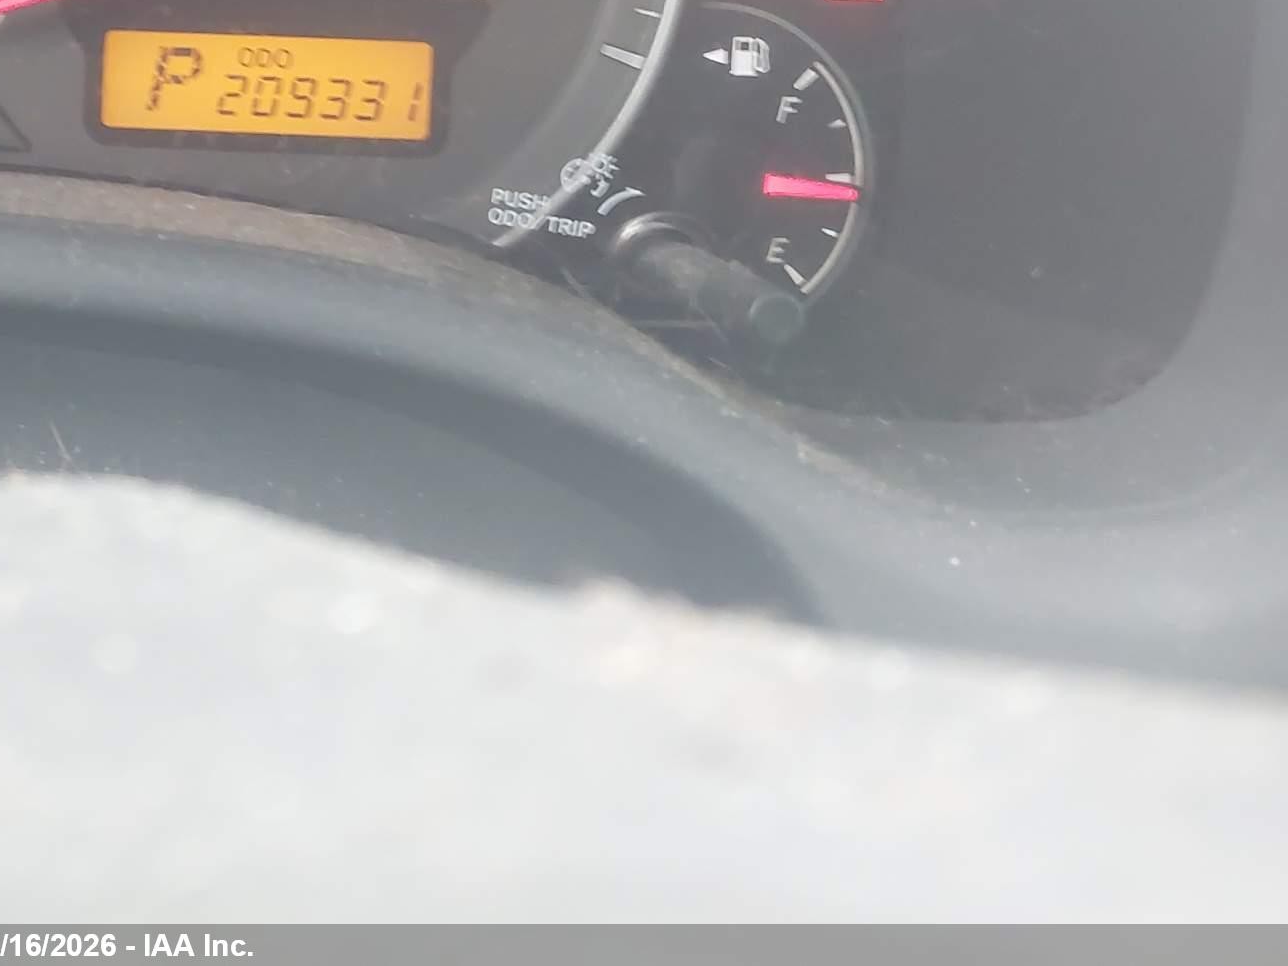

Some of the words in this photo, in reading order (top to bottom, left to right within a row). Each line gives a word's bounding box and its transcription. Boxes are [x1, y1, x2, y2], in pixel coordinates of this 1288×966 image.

[145, 45, 203, 112] P
[216, 73, 423, 122] 209331
[775, 95, 804, 124] F
[490, 187, 551, 211] PUSH
[765, 236, 791, 264] E
